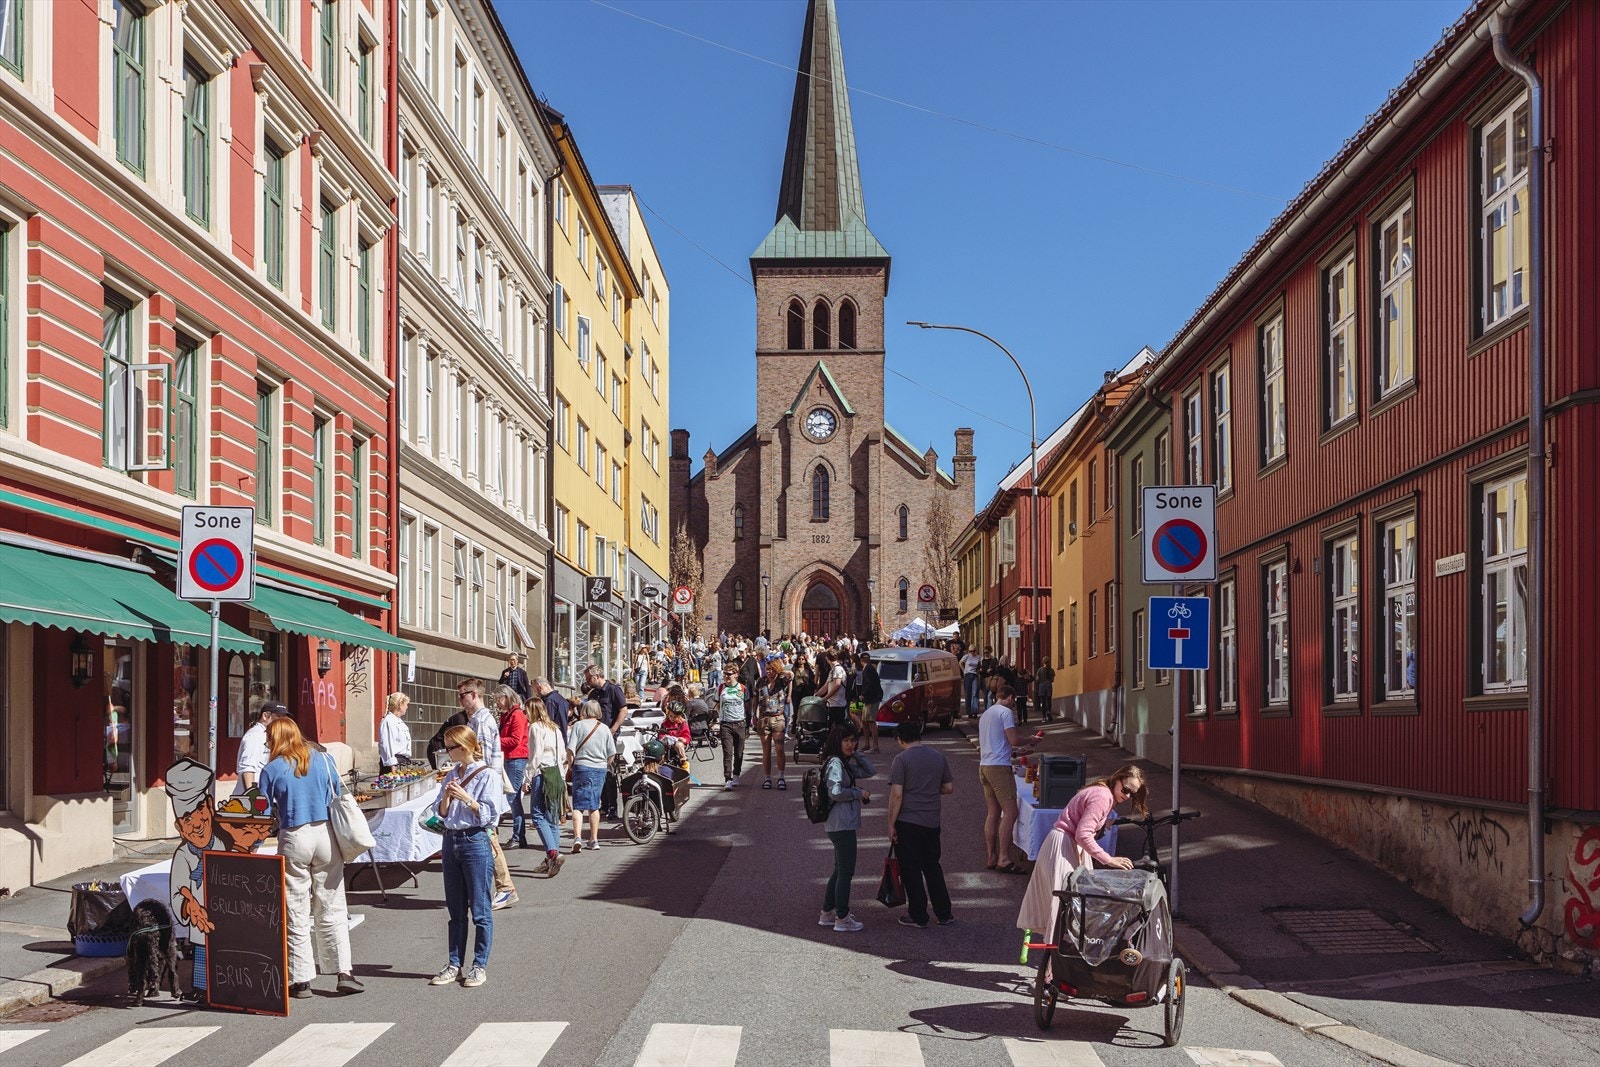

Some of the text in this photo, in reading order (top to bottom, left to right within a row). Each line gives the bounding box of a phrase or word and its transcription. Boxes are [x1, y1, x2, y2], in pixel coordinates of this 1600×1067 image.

[1155, 492, 1203, 510] Sone
[194, 511, 242, 529] Sone
[811, 534, 831, 544] 1882
[301, 677, 338, 710] ACAB
